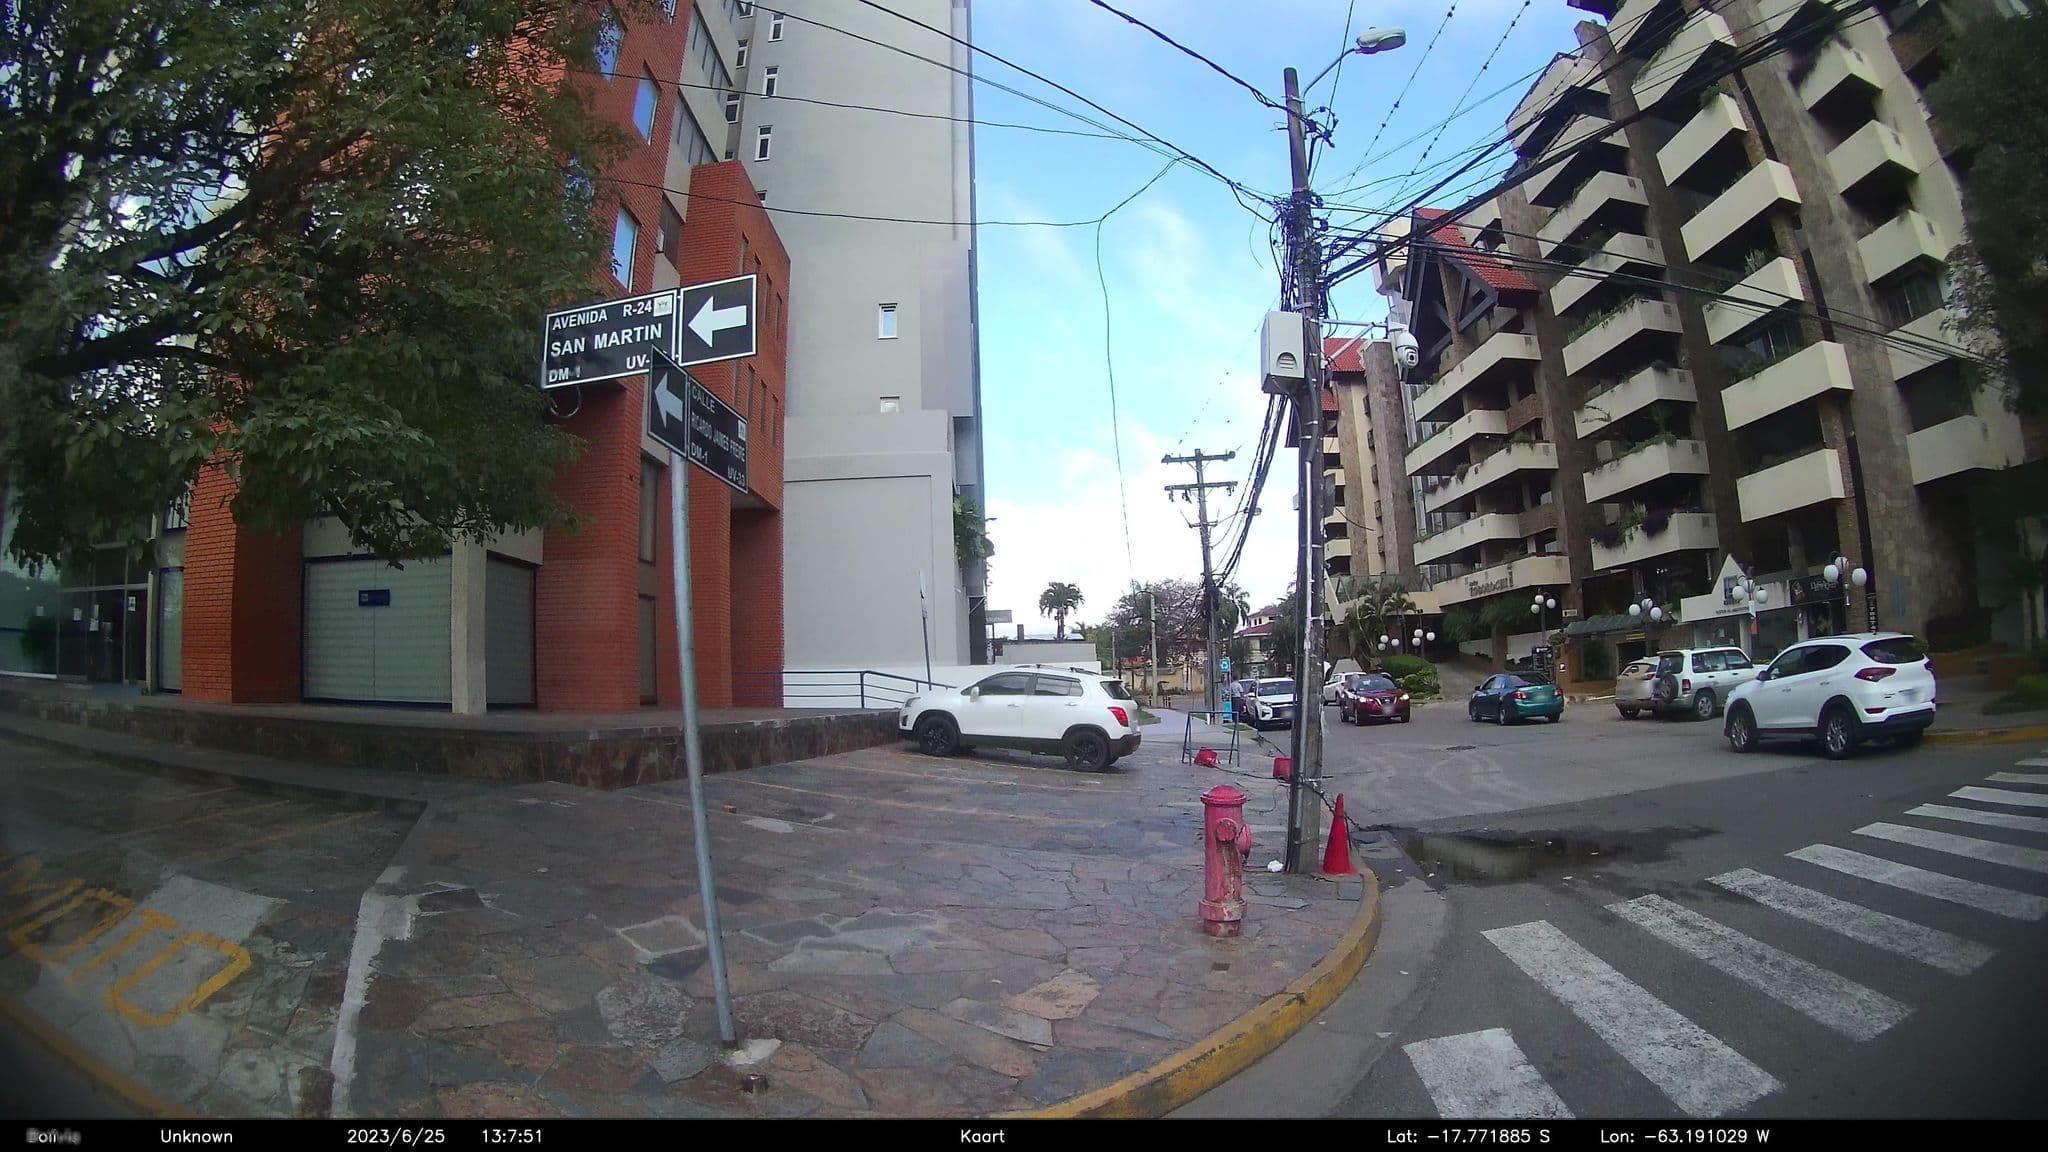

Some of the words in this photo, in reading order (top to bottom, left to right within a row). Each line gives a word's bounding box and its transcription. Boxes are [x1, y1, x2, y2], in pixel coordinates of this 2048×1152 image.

[552, 309, 608, 331] AVENIDA
[623, 300, 652, 317] R-24
[550, 337, 586, 358] SAN
[594, 323, 662, 350] MARTIN
[626, 353, 650, 369] UV-
[691, 385, 716, 414] CALLE
[691, 442, 708, 464] DM-1
